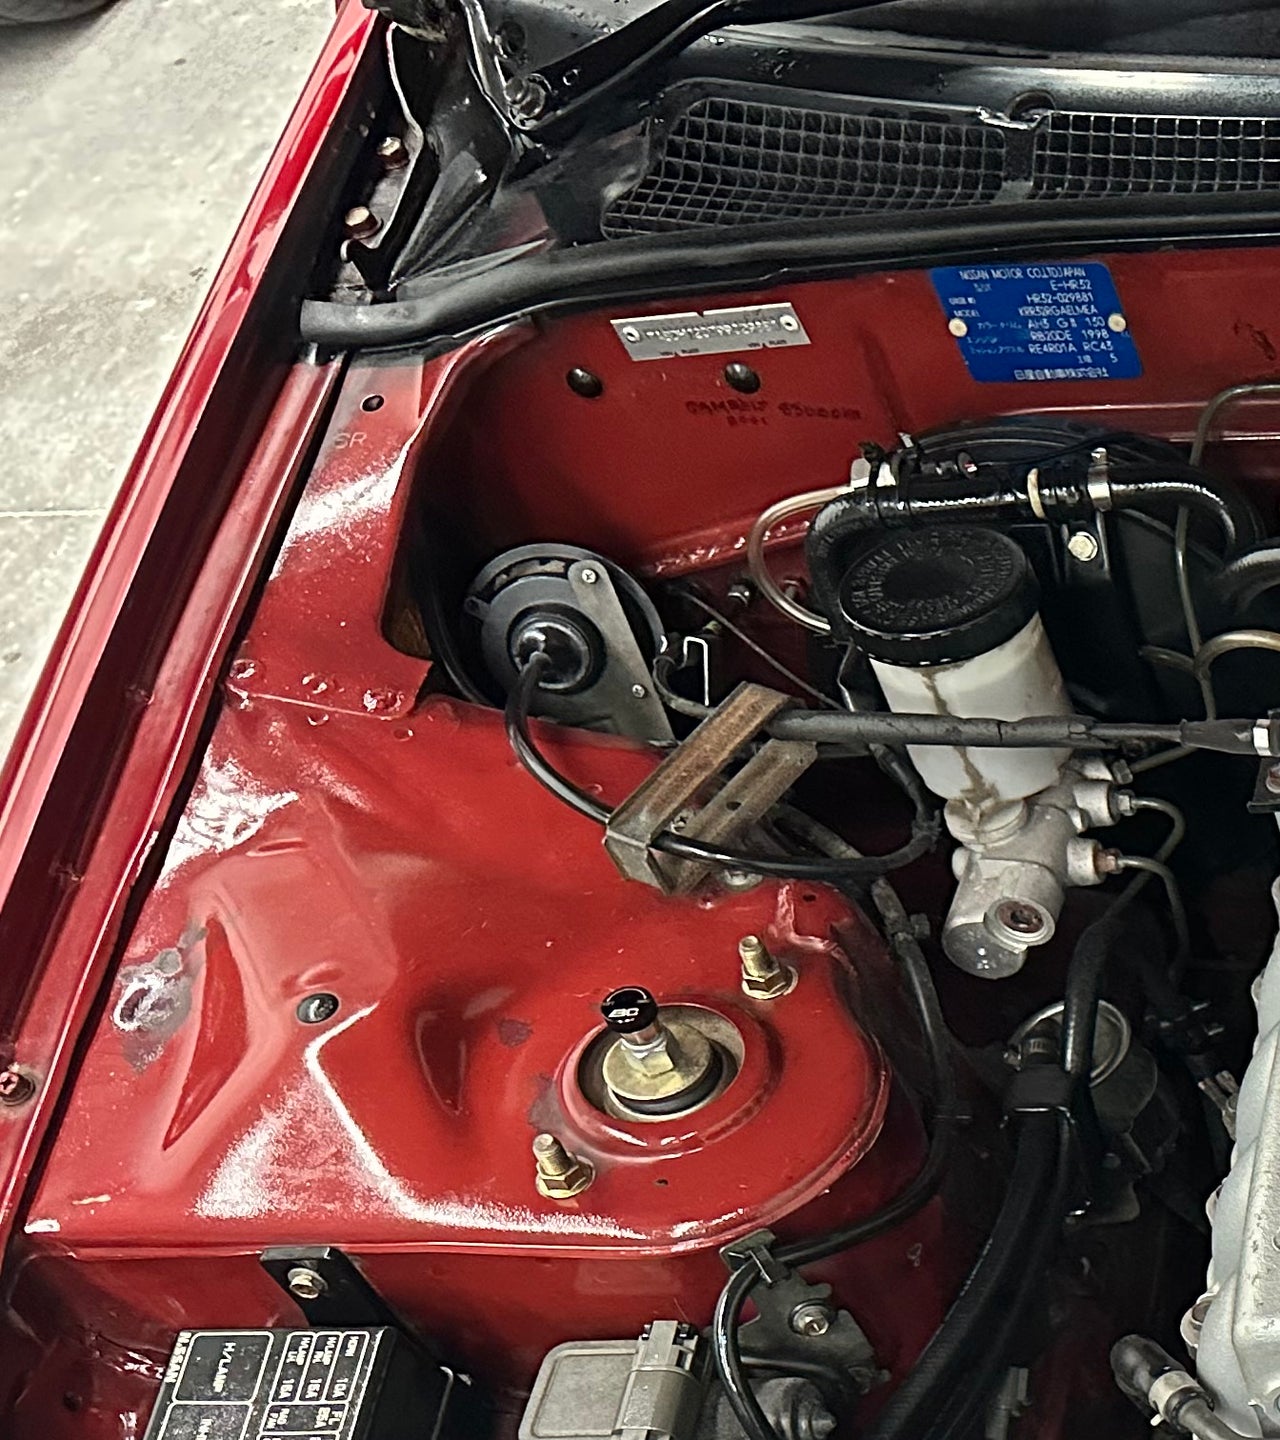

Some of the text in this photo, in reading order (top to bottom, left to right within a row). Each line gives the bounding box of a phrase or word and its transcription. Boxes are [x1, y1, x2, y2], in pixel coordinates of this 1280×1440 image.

[959, 268, 990, 280] NISSAN
[992, 268, 1022, 280] MOTOR
[1030, 329, 1109, 341] RB20DE 1998
[1028, 342, 1077, 354] RE4R01A
[1083, 341, 1113, 352] RC43
[334, 432, 367, 448] SR
[164, 1332, 193, 1384] NISSAN
[209, 1342, 236, 1392] H/LAMP
[327, 1411, 342, 1424] FL
